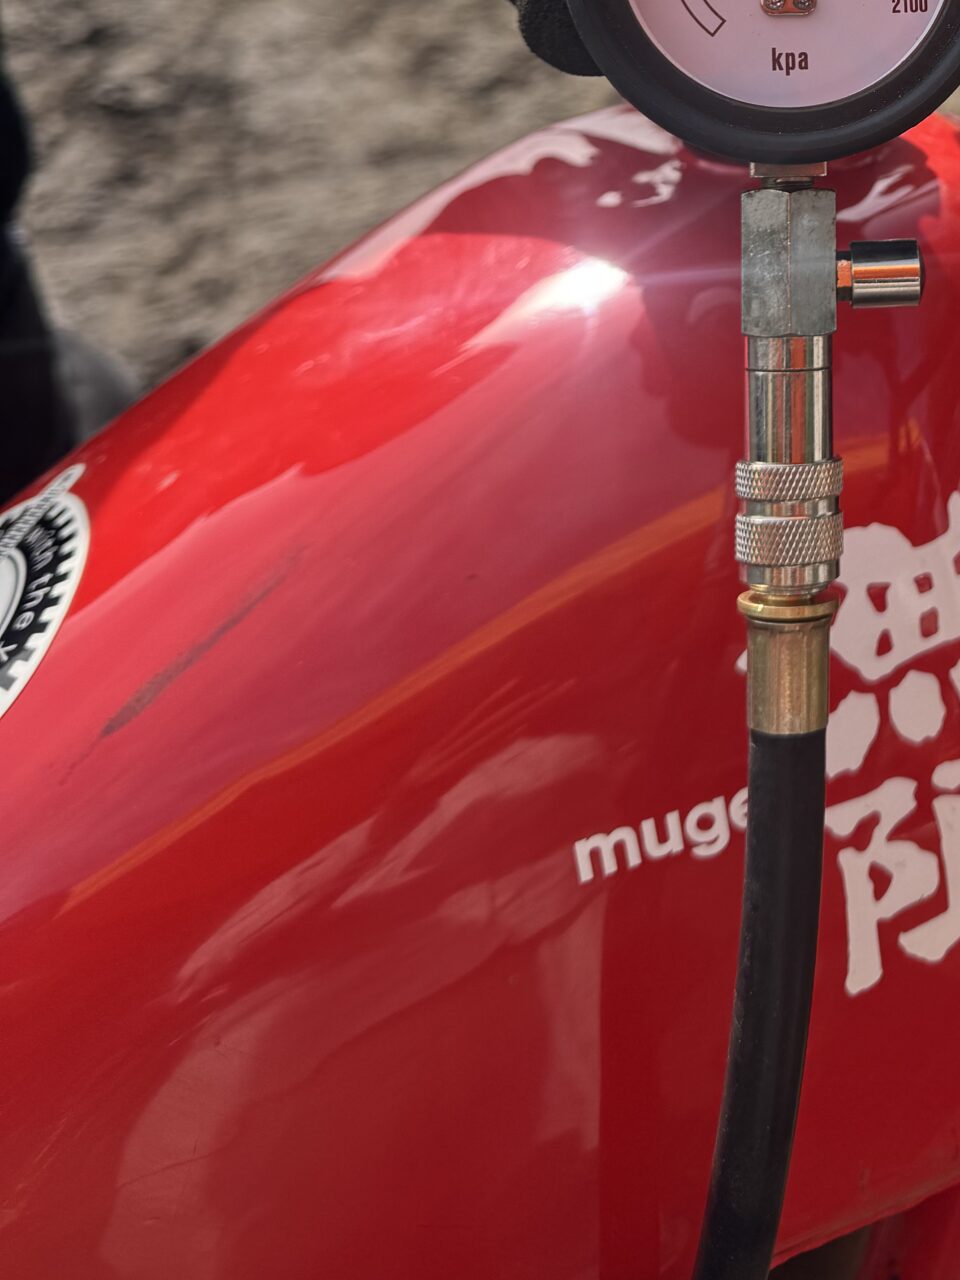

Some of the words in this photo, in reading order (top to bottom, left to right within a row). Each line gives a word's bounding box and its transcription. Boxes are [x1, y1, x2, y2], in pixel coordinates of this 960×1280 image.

[771, 48, 809, 75] kpa
[15, 574, 52, 631] the
[574, 786, 748, 884] muge
